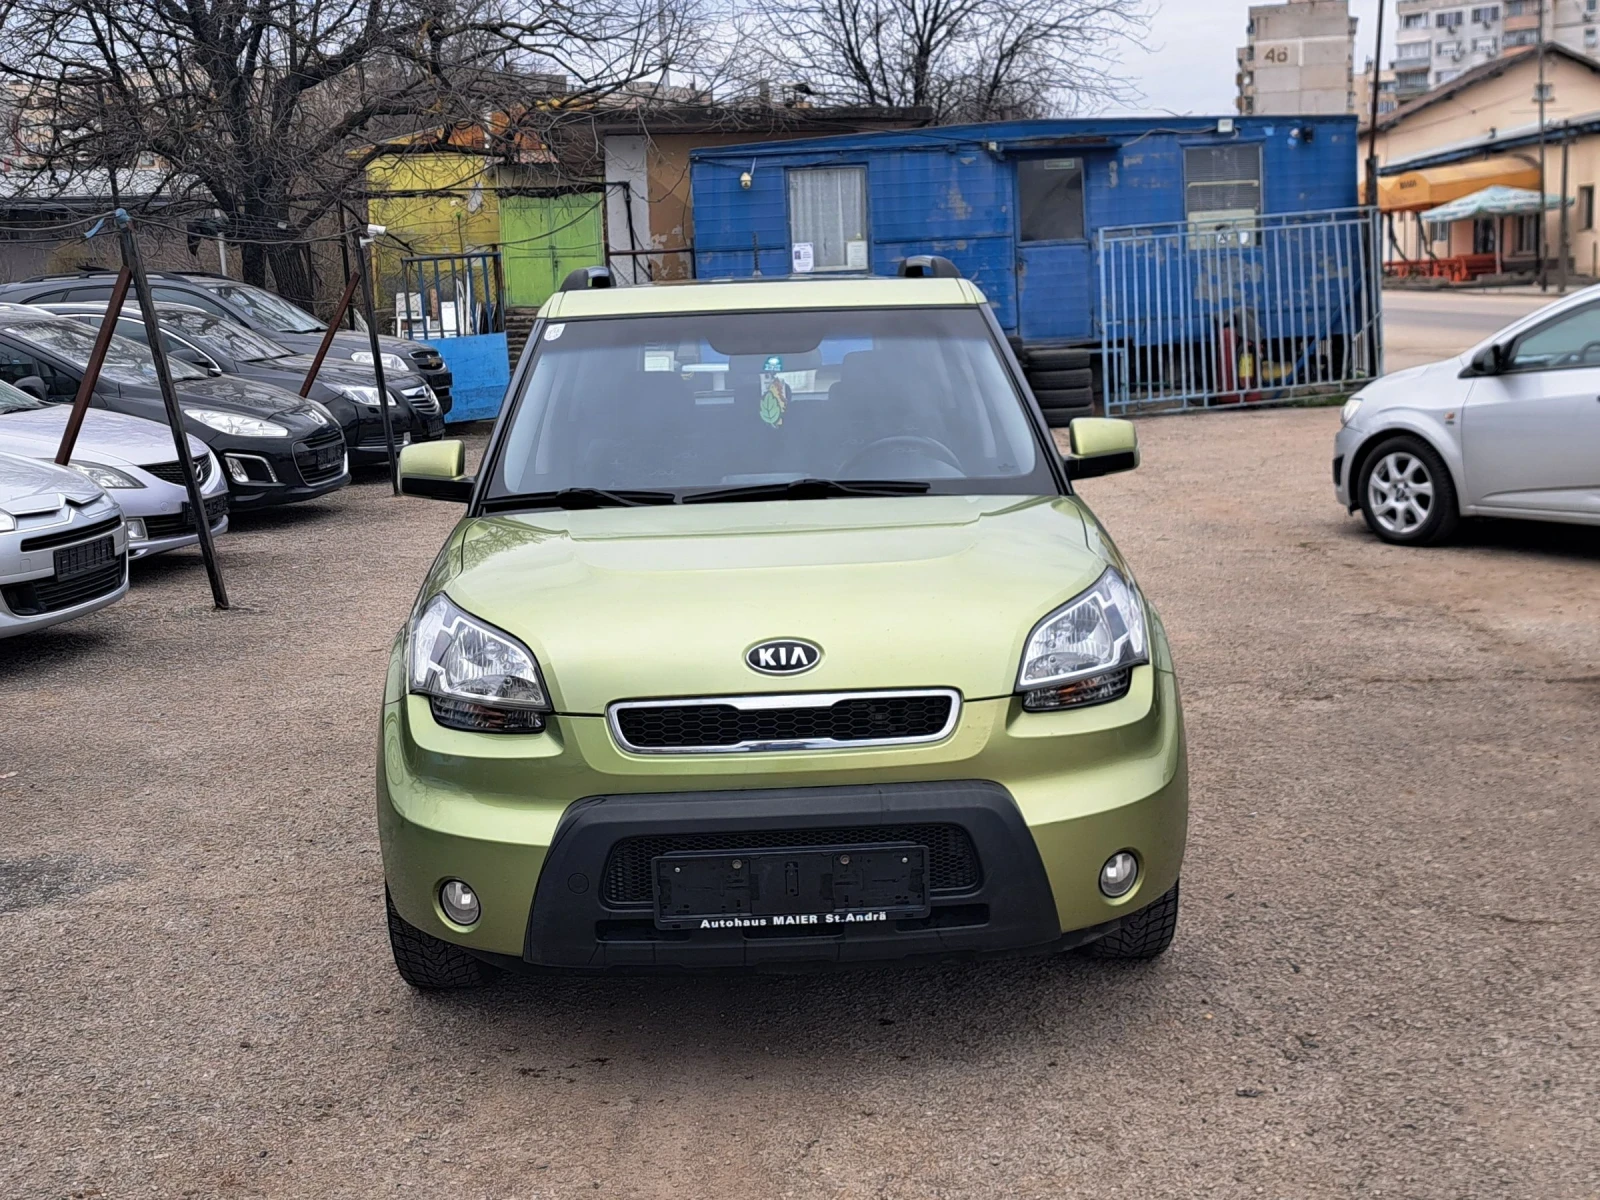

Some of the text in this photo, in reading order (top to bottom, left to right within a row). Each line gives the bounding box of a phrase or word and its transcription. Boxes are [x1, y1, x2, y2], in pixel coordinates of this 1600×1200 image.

[758, 646, 809, 667] KIA
[700, 911, 887, 929] Autohaus MAIER St.Andrä
